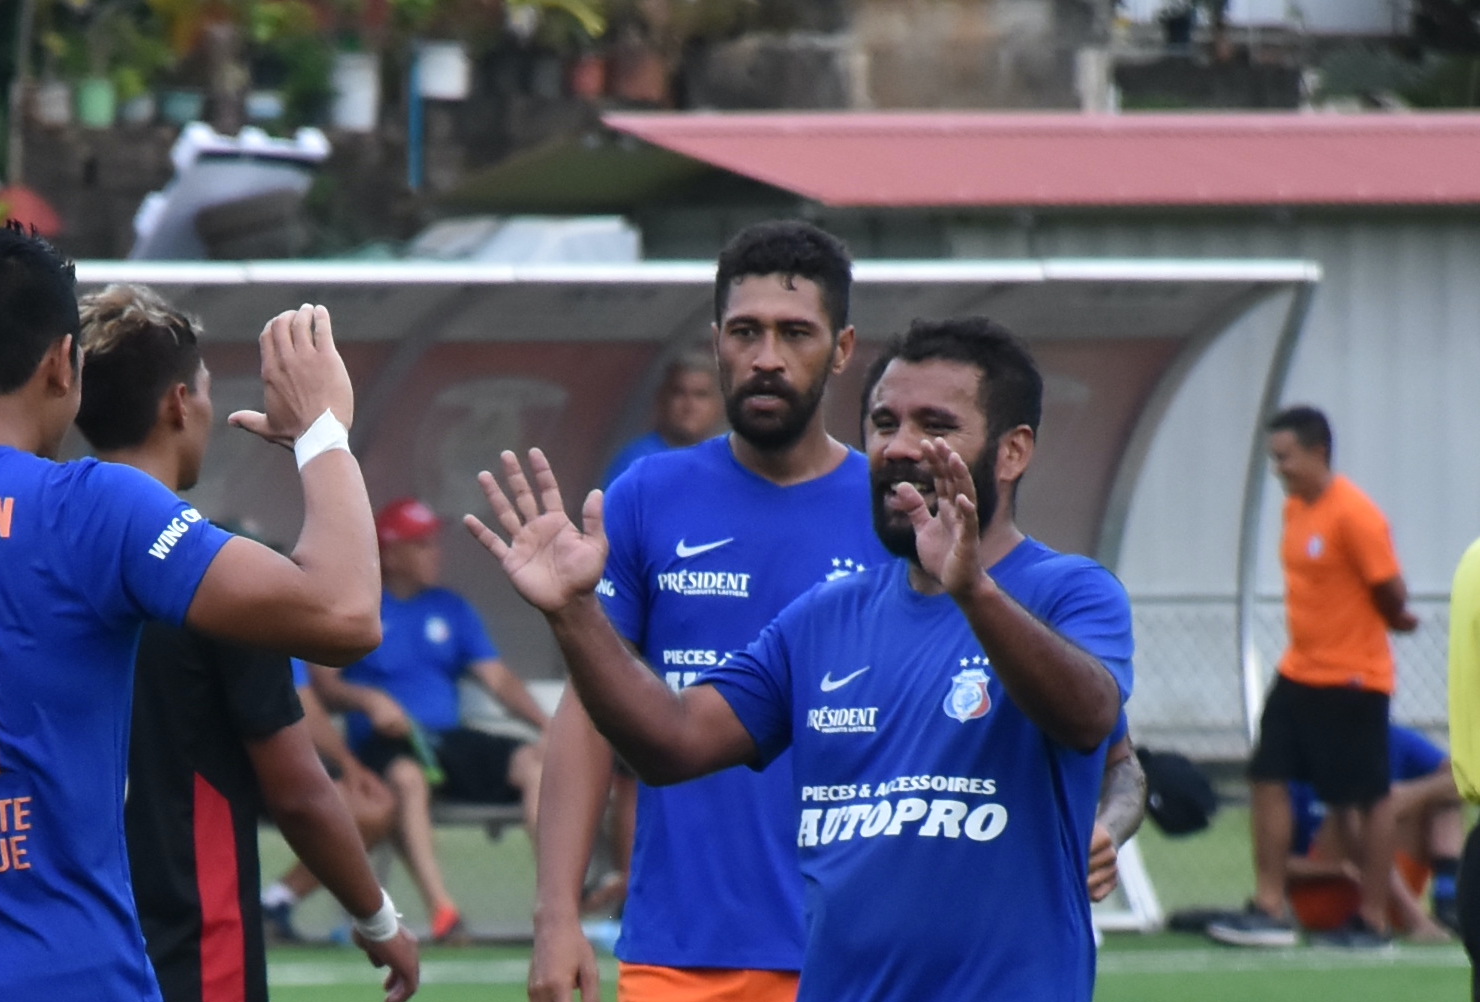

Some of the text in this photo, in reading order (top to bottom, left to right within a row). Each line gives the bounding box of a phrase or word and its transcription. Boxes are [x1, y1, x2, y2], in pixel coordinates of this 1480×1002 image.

[148, 517, 189, 560] WING
[658, 569, 750, 593] PRÉSIDENT
[663, 650, 717, 666] PIECES
[801, 784, 857, 801] PIECES
[858, 784, 871, 798] &
[797, 797, 1009, 847] AUTOPRO
